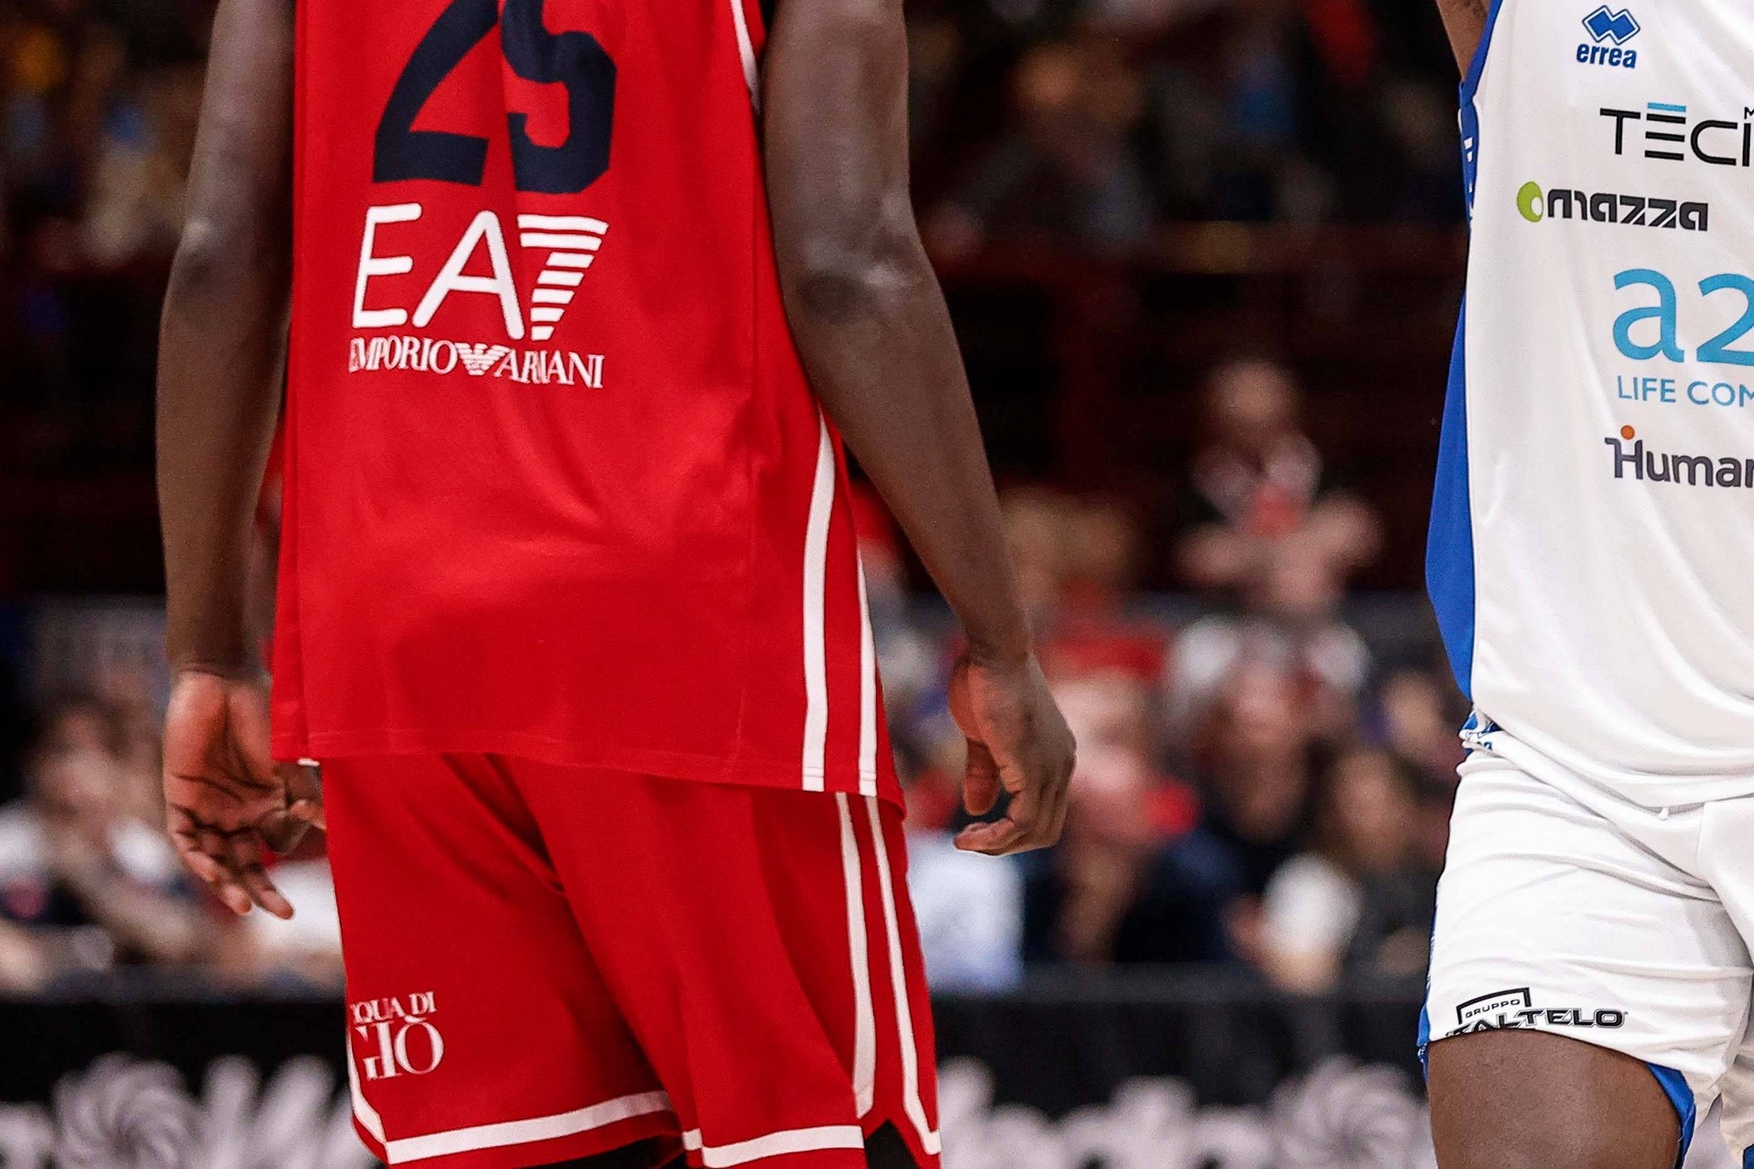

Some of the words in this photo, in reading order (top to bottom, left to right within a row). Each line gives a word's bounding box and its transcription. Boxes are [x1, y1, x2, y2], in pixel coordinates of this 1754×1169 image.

[351, 202, 608, 340] EA7
[1617, 375, 1676, 404] LIFE
[350, 996, 406, 1024] QUA
[408, 991, 438, 1015] DI
[1465, 999, 1520, 1018] GRUPPO
